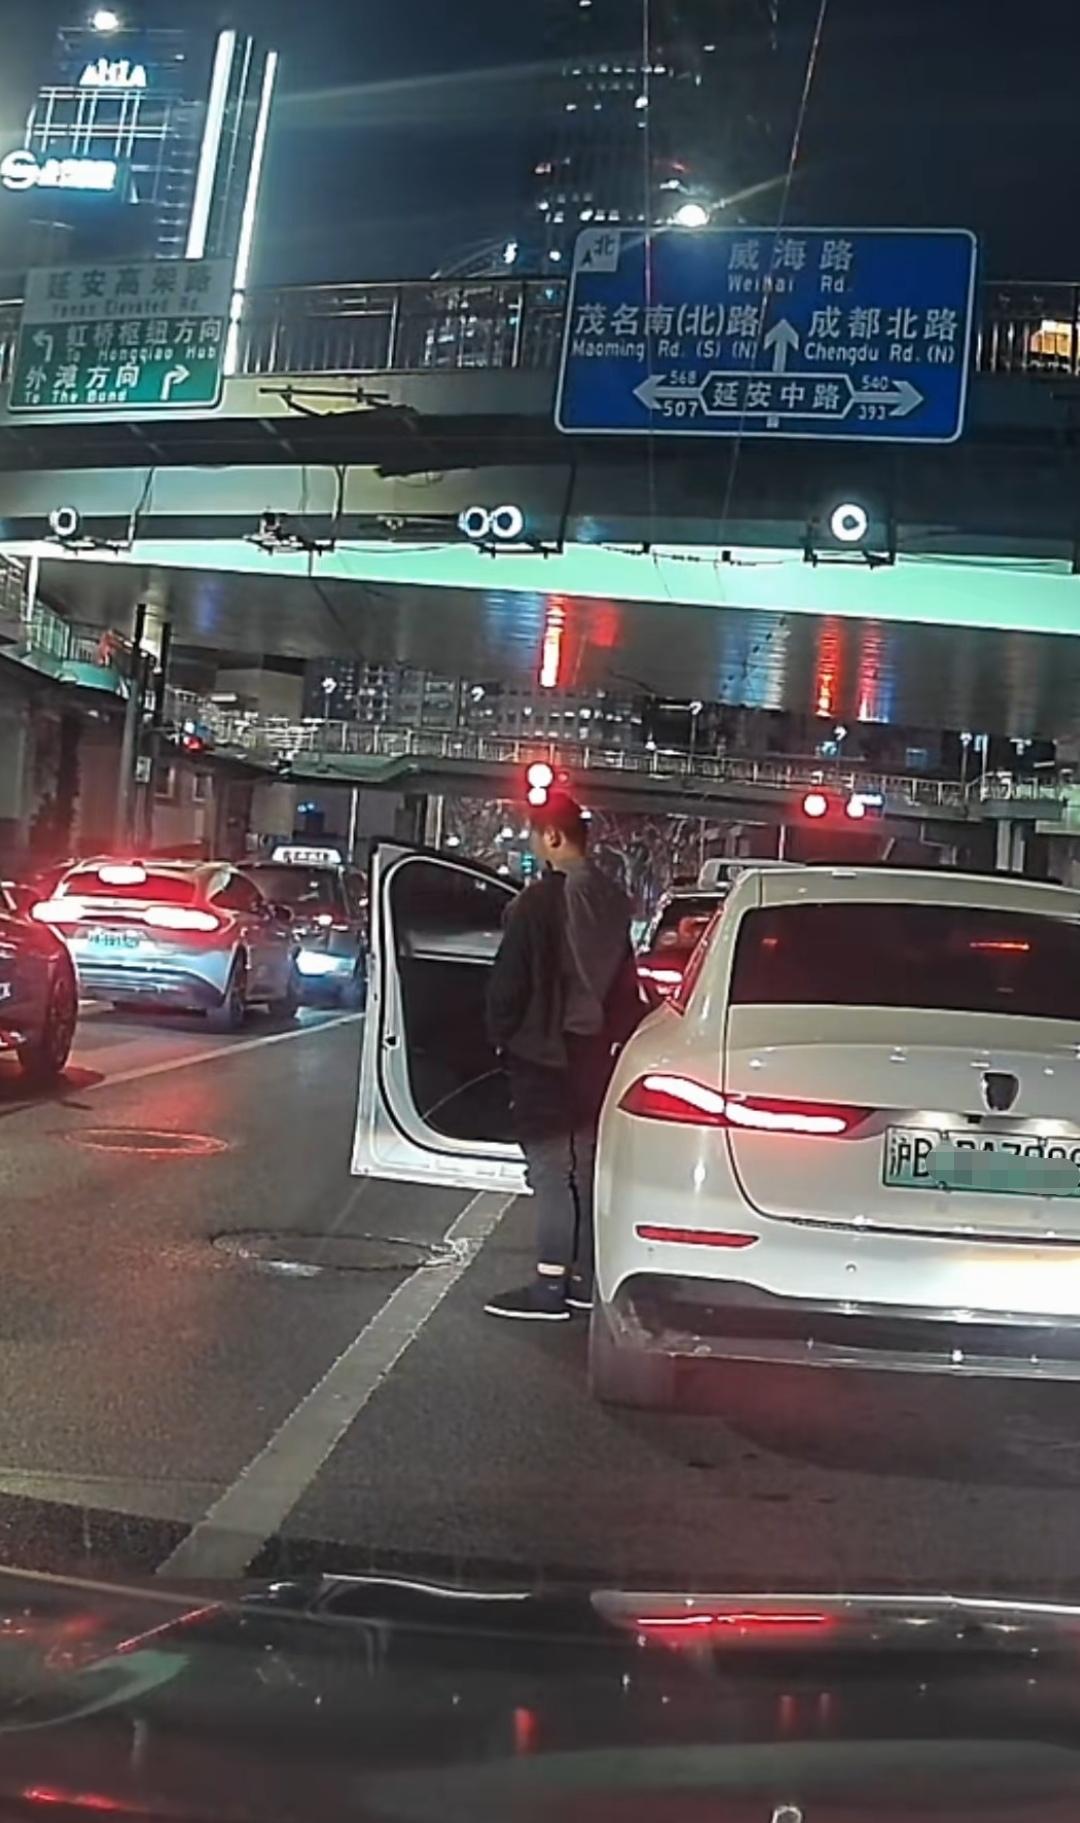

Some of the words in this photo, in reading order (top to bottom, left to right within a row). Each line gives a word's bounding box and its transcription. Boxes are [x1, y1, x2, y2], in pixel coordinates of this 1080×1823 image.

[593, 235, 616, 256] 北
[728, 238, 854, 272] 威海路
[728, 274, 795, 293] Weihai
[574, 303, 761, 337] 茂名南(北)路
[808, 306, 958, 342] 成都北路
[572, 340, 645, 360] Maoming
[695, 340, 720, 360] (S)
[732, 340, 759, 361] (N)
[804, 343, 880, 364] Chengdu
[890, 344, 921, 362] Rd.
[927, 344, 955, 364] (N)
[24, 363, 141, 390] 外滩方向
[669, 370, 697, 385] 568
[861, 375, 889, 391] 540
[712, 381, 841, 410] 延安中路
[662, 399, 699, 417] 507
[857, 404, 887, 421] 393
